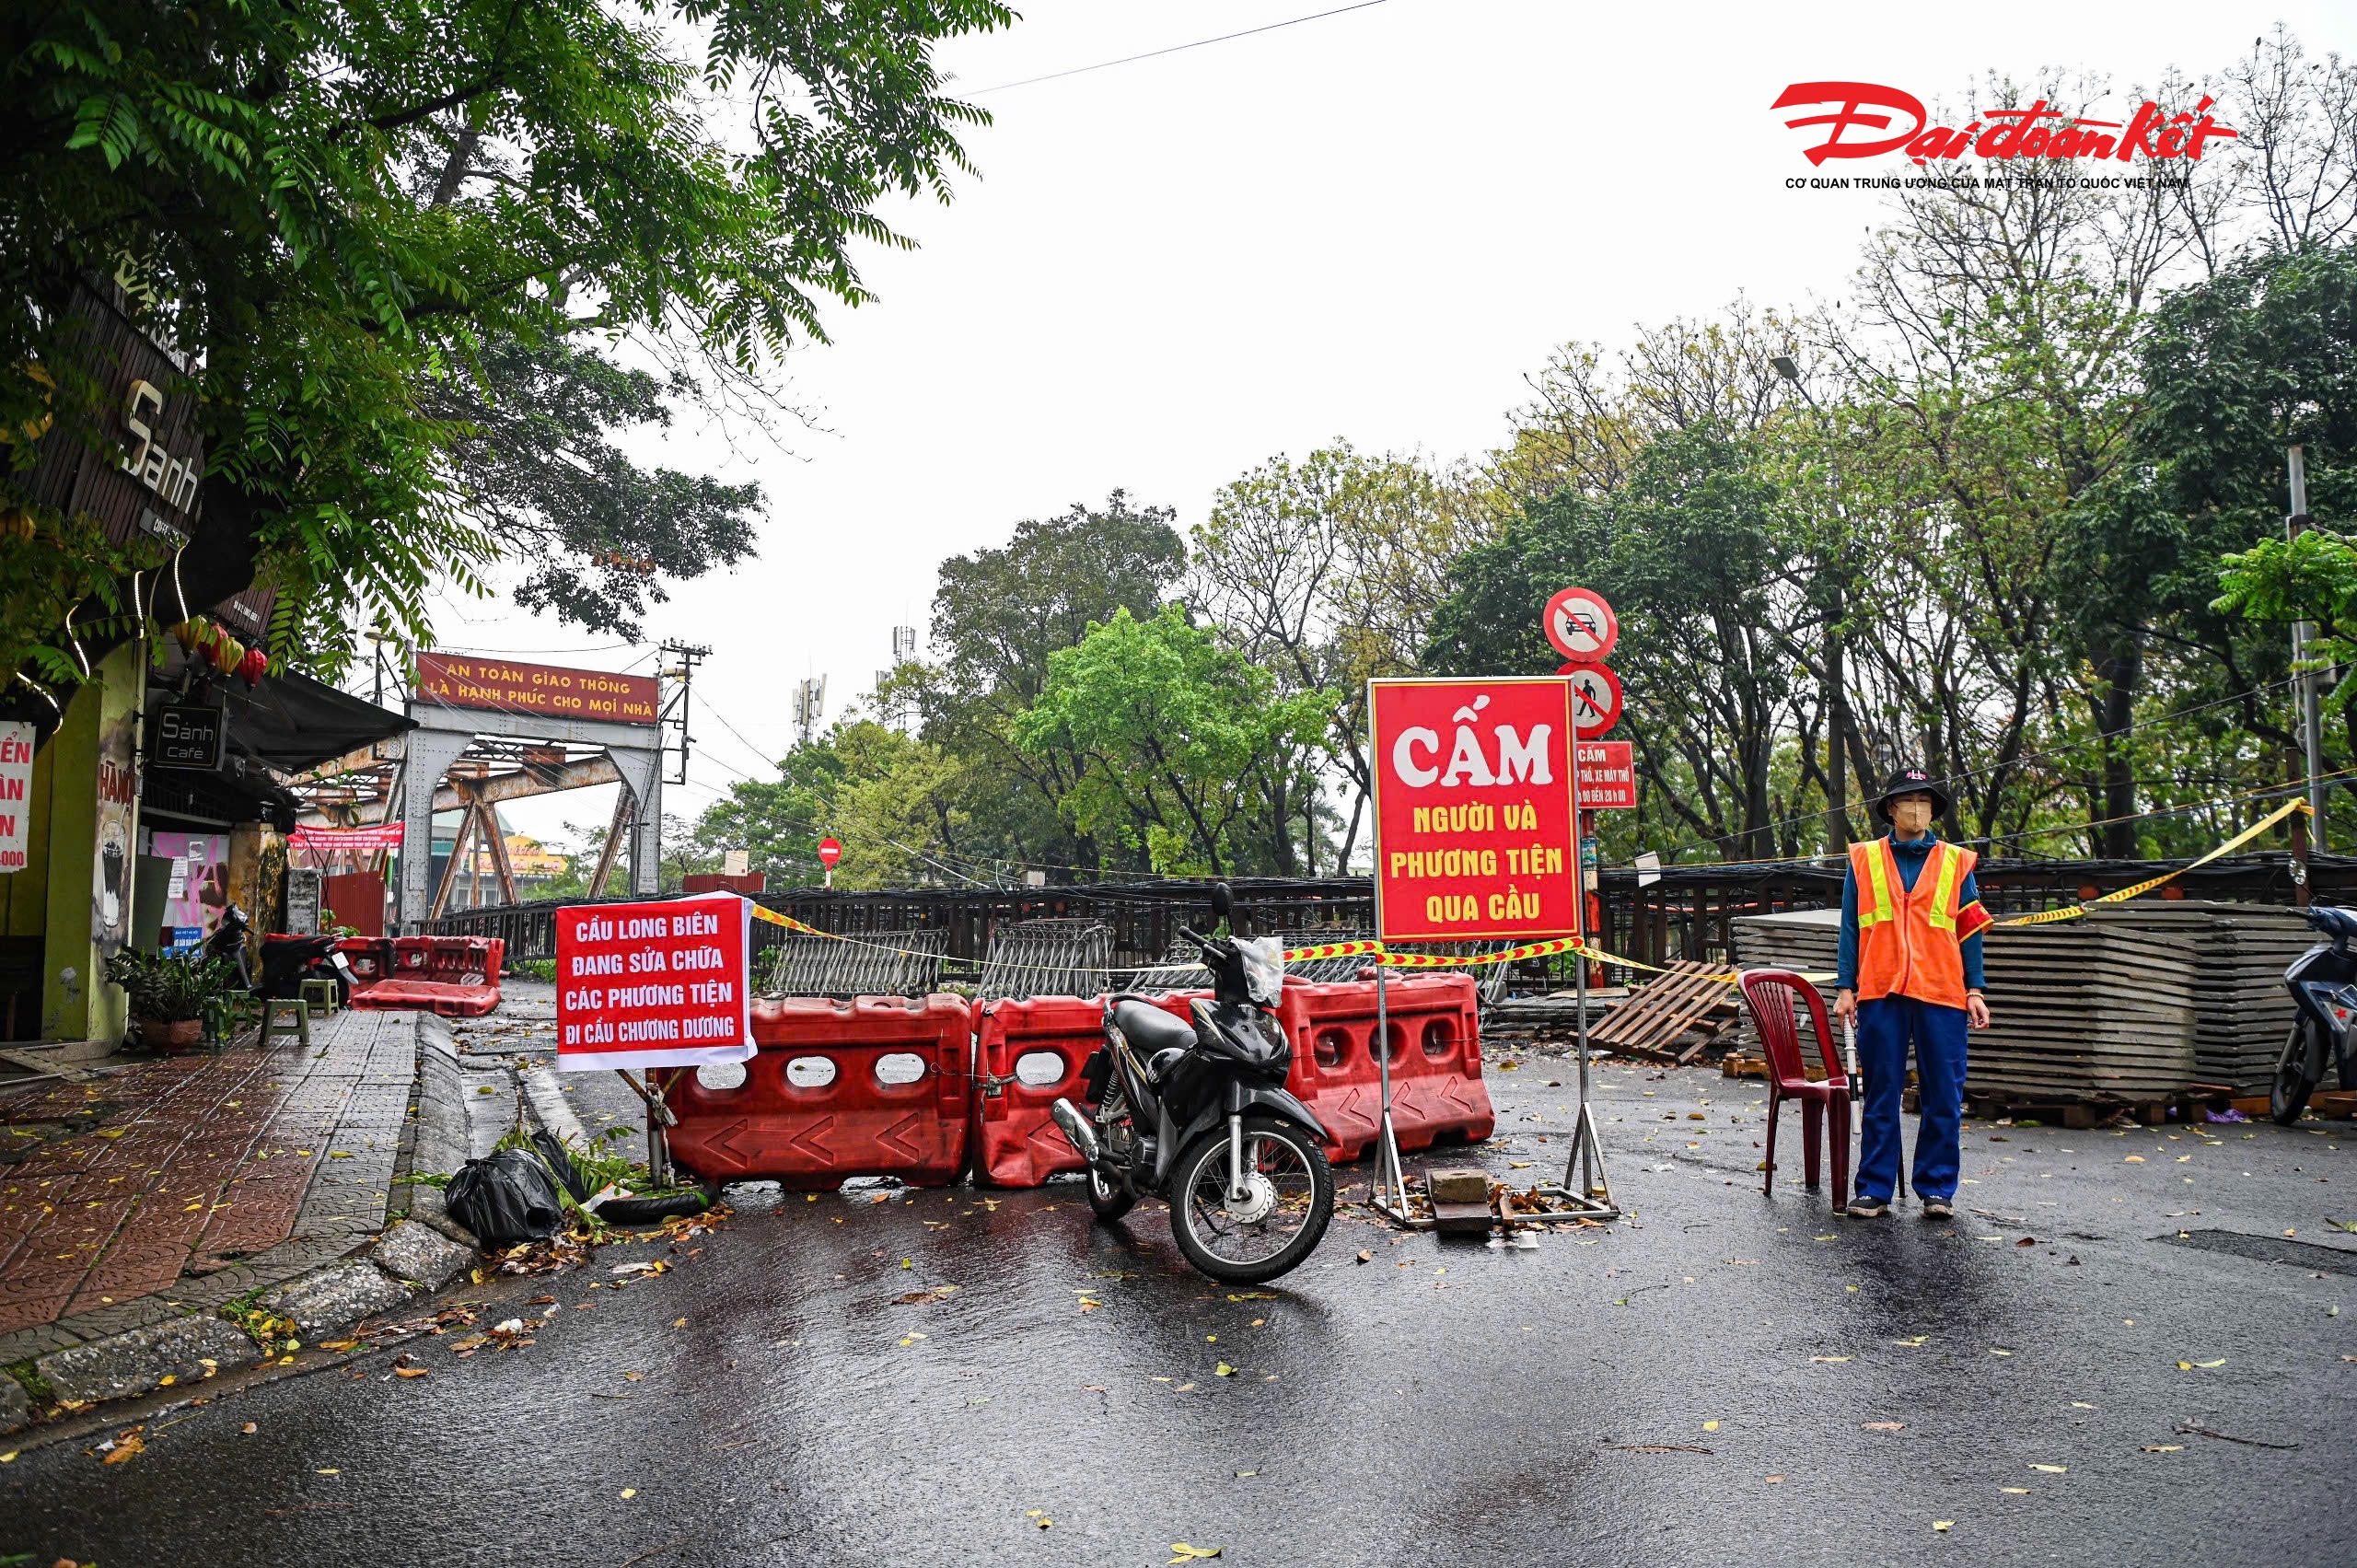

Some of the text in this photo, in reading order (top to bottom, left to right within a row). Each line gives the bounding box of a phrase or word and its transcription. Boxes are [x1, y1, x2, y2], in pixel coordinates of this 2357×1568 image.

[447, 663, 470, 677] AN
[479, 665, 524, 682] TOÀN
[580, 676, 631, 694] THÔNG
[430, 679, 450, 695] LÀ
[459, 685, 501, 701] HẠNH
[508, 688, 546, 705] PHÚC
[552, 695, 582, 708] CHO
[623, 701, 653, 716] NHÀ
[0, 731, 30, 764] ỂN
[1393, 694, 1554, 788] CẤM
[1577, 745, 1607, 762] CẤM
[1595, 769, 1603, 783] XE
[1604, 767, 1617, 783] MÁY
[1413, 799, 1538, 833] NGƯỜI VÀ
[1390, 842, 1562, 880] PHƯƠNG TIỆN
[1426, 883, 1540, 923] QUA CẦU
[575, 912, 718, 943] CẦU LONG BIÊN
[572, 945, 724, 977] ĐANG SỬA CHỮA
[565, 979, 733, 1011] CÁC PHƯƠNG TIỆN
[565, 1016, 735, 1045] ĐI CẦU CHƯƠNG DƯƠNG
